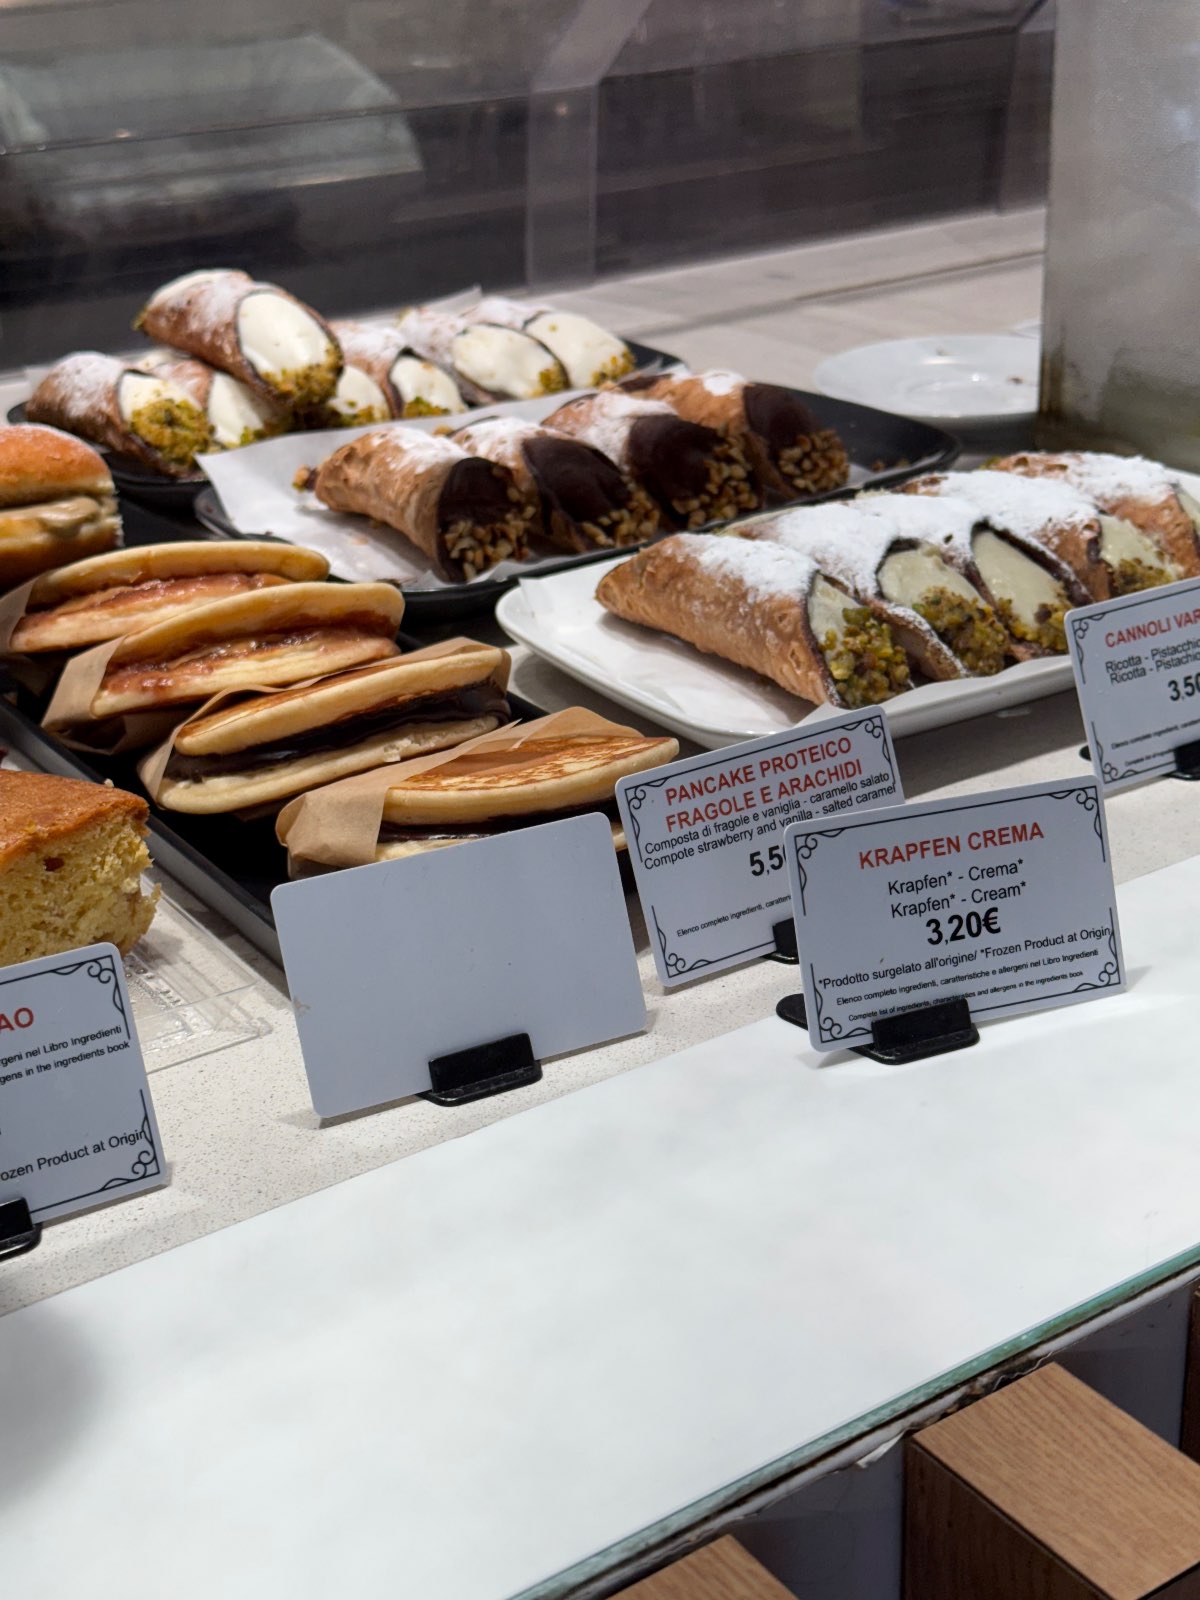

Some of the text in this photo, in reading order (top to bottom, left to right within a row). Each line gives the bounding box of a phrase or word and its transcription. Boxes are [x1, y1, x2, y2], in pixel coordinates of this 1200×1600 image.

[1105, 617, 1171, 648] CANNOLI
[1105, 656, 1142, 673] Ricotta
[1110, 667, 1147, 684] Ricotta
[665, 737, 851, 806] PANCAKE PROTEICO
[645, 830, 700, 854] Composta
[702, 825, 712, 837] di
[714, 815, 750, 833] fragole
[752, 812, 759, 821] e
[762, 799, 801, 818] vaniglia
[810, 782, 858, 804] caramello
[860, 772, 890, 789] salato
[666, 759, 862, 833] FRAGOLE E ARACHIDI
[644, 847, 695, 870] Compote
[698, 829, 753, 854] strawberry
[757, 819, 777, 835] and
[779, 809, 813, 828] vanilla
[822, 796, 853, 815] salted
[855, 783, 896, 803] caramel
[859, 822, 1044, 869] KRAPFEN CREMA
[749, 844, 786, 877] 5,5
[676, 925, 700, 937] Elenco
[701, 915, 729, 930] completo
[765, 894, 792, 909] caratteri
[925, 907, 1001, 945] 3,20€
[872, 962, 922, 979] surgelato
[925, 948, 977, 969] all'origine/
[1024, 935, 1065, 950] Product
[1067, 932, 1077, 942] at
[1080, 926, 1111, 941] Origin
[837, 995, 862, 1006] Elenco
[864, 988, 897, 1002] completo
[940, 969, 990, 986] caratteristiche
[998, 962, 1028, 973] allergeni
[1030, 959, 1041, 968] nel
[1043, 956, 1061, 966] Libro
[1062, 949, 1099, 963] Ingredienti
[848, 1010, 878, 1021] Complete
[977, 988, 989, 996] and
[990, 983, 1017, 994] allergens
[1025, 979, 1034, 987] the
[1035, 973, 1068, 985] ingredients
[0, 1007, 34, 1034] AO
[25, 1047, 41, 1059] nel
[43, 1041, 69, 1054] Libro
[71, 1025, 122, 1046] Ingredienti
[25, 1067, 34, 1077] in
[36, 1062, 52, 1073] the
[54, 1048, 105, 1068] ingredients
[107, 1041, 130, 1054] book
[37, 1145, 90, 1170] Product
[93, 1140, 106, 1153] at
[108, 1129, 147, 1148] Origin
